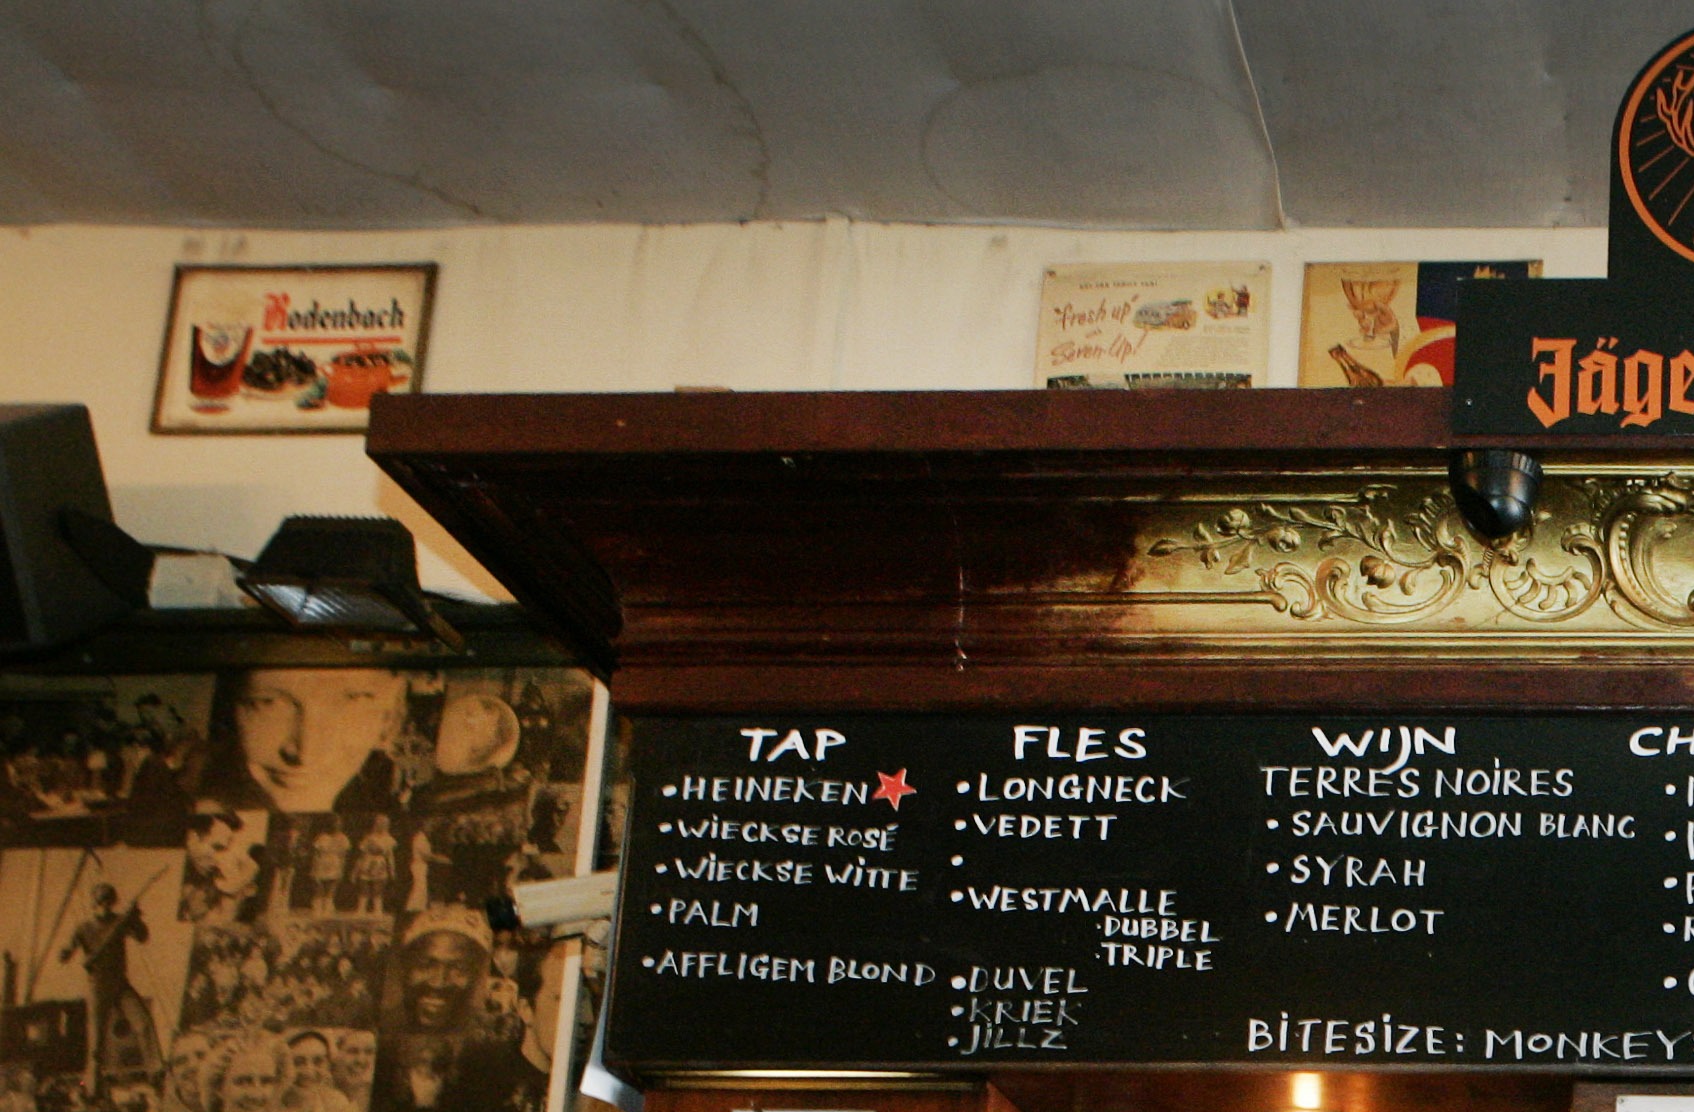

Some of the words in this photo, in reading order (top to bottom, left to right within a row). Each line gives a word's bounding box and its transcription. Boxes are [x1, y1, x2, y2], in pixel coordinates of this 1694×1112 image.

[264, 292, 404, 331] Rodenbach
[740, 727, 847, 762] TAP
[1013, 725, 1148, 762] FLES
[1312, 725, 1457, 775] WIJN
[682, 775, 868, 805] HEINEKEN
[979, 772, 1190, 803] LONGNECK
[1260, 765, 1421, 799] TERRES
[1435, 757, 1575, 798] NOIRES
[677, 813, 822, 846] WIECKSE
[827, 822, 900, 851] ROSÉ
[972, 813, 1118, 840] VEDETT
[1291, 809, 1523, 840] SAUVIGNON
[1538, 812, 1637, 840] BLANC
[674, 851, 814, 885] WIECKSE
[824, 856, 920, 891] WITTE
[1290, 853, 1426, 888] SYRAH
[669, 898, 759, 928] PALM
[968, 885, 1178, 916] WESTMALLE
[1104, 914, 1221, 942] DUBBEL
[1285, 902, 1446, 935] MERLOT
[656, 950, 815, 984] AFFLIGEM
[827, 955, 937, 987] BLOND
[1101, 942, 1214, 972] TRIPLE
[968, 965, 1089, 995] DUVEL
[969, 997, 1083, 1026] KRIEK
[960, 1021, 1067, 1056] JILLZ
